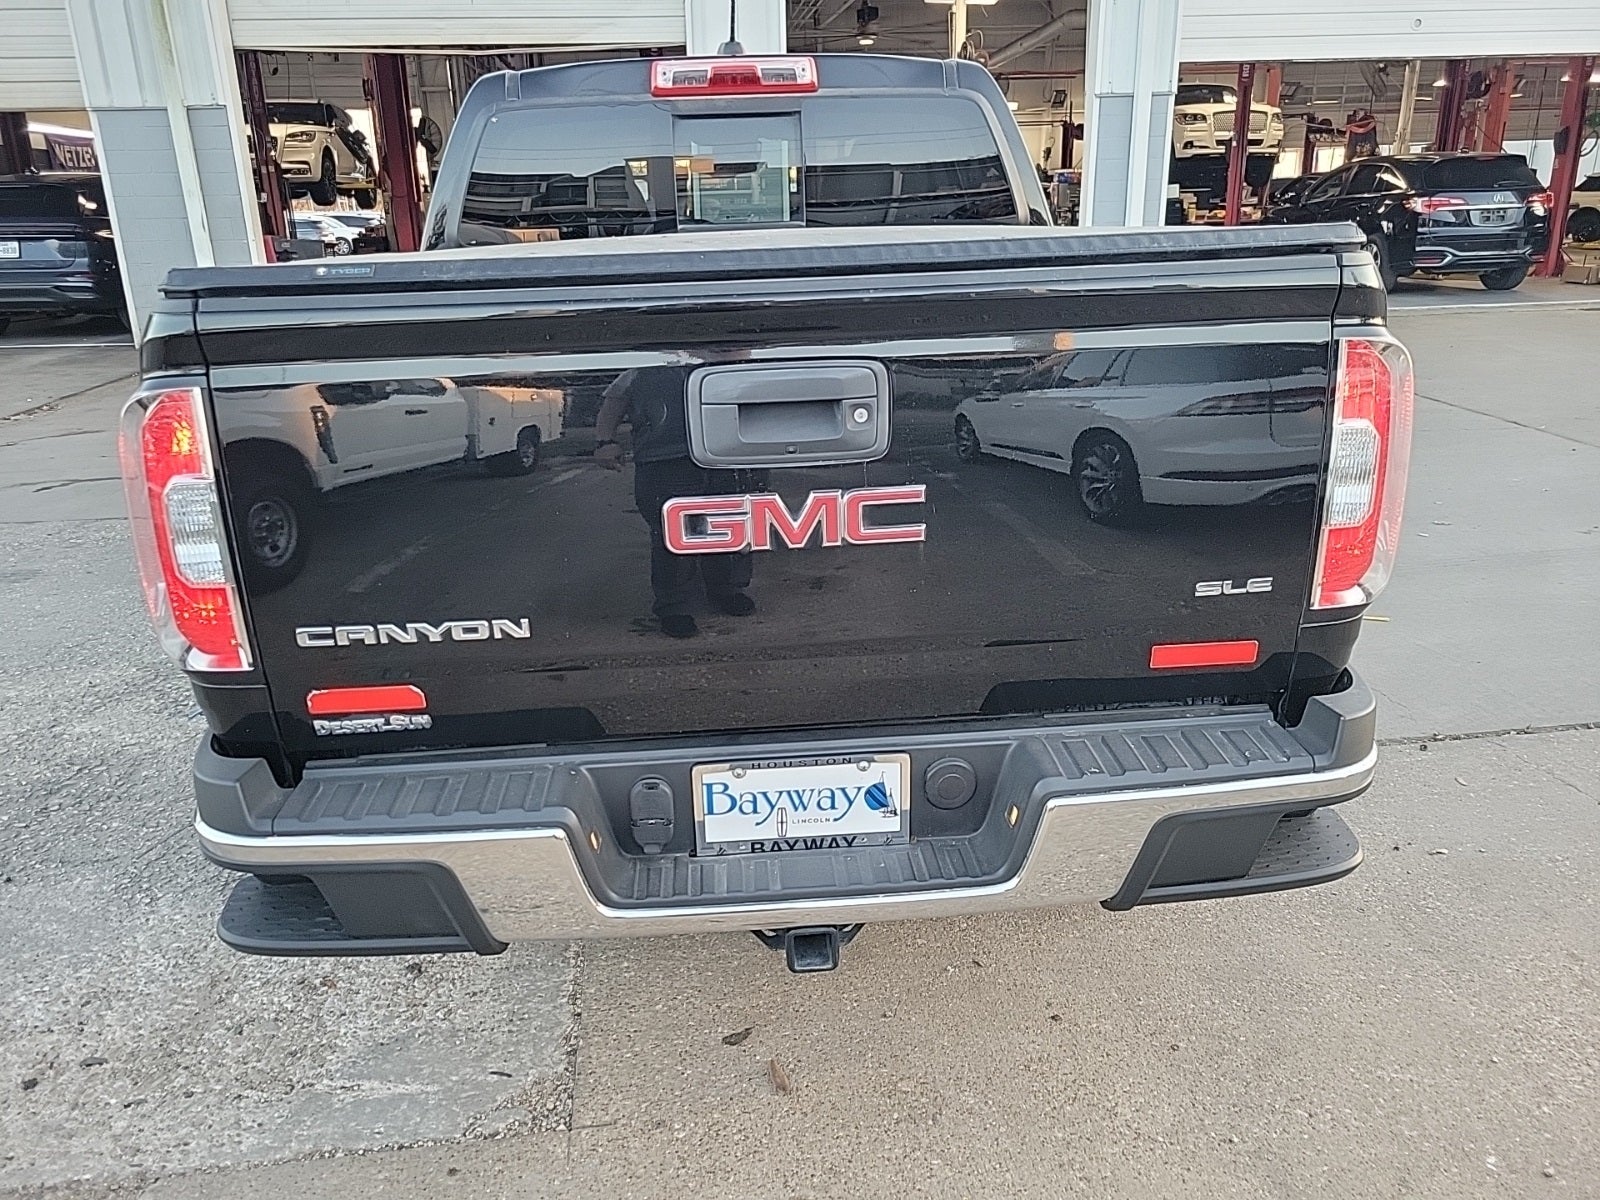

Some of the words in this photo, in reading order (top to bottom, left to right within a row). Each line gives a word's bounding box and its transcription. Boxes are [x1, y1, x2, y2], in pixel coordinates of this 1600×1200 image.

[662, 484, 927, 555] GMC
[1195, 576, 1274, 597] SLE
[295, 618, 531, 648] CANYON
[751, 757, 852, 769] HOUSTON
[702, 782, 866, 827] Bayway
[791, 817, 832, 825] LINCOLN
[750, 835, 858, 853] BAYWAY
